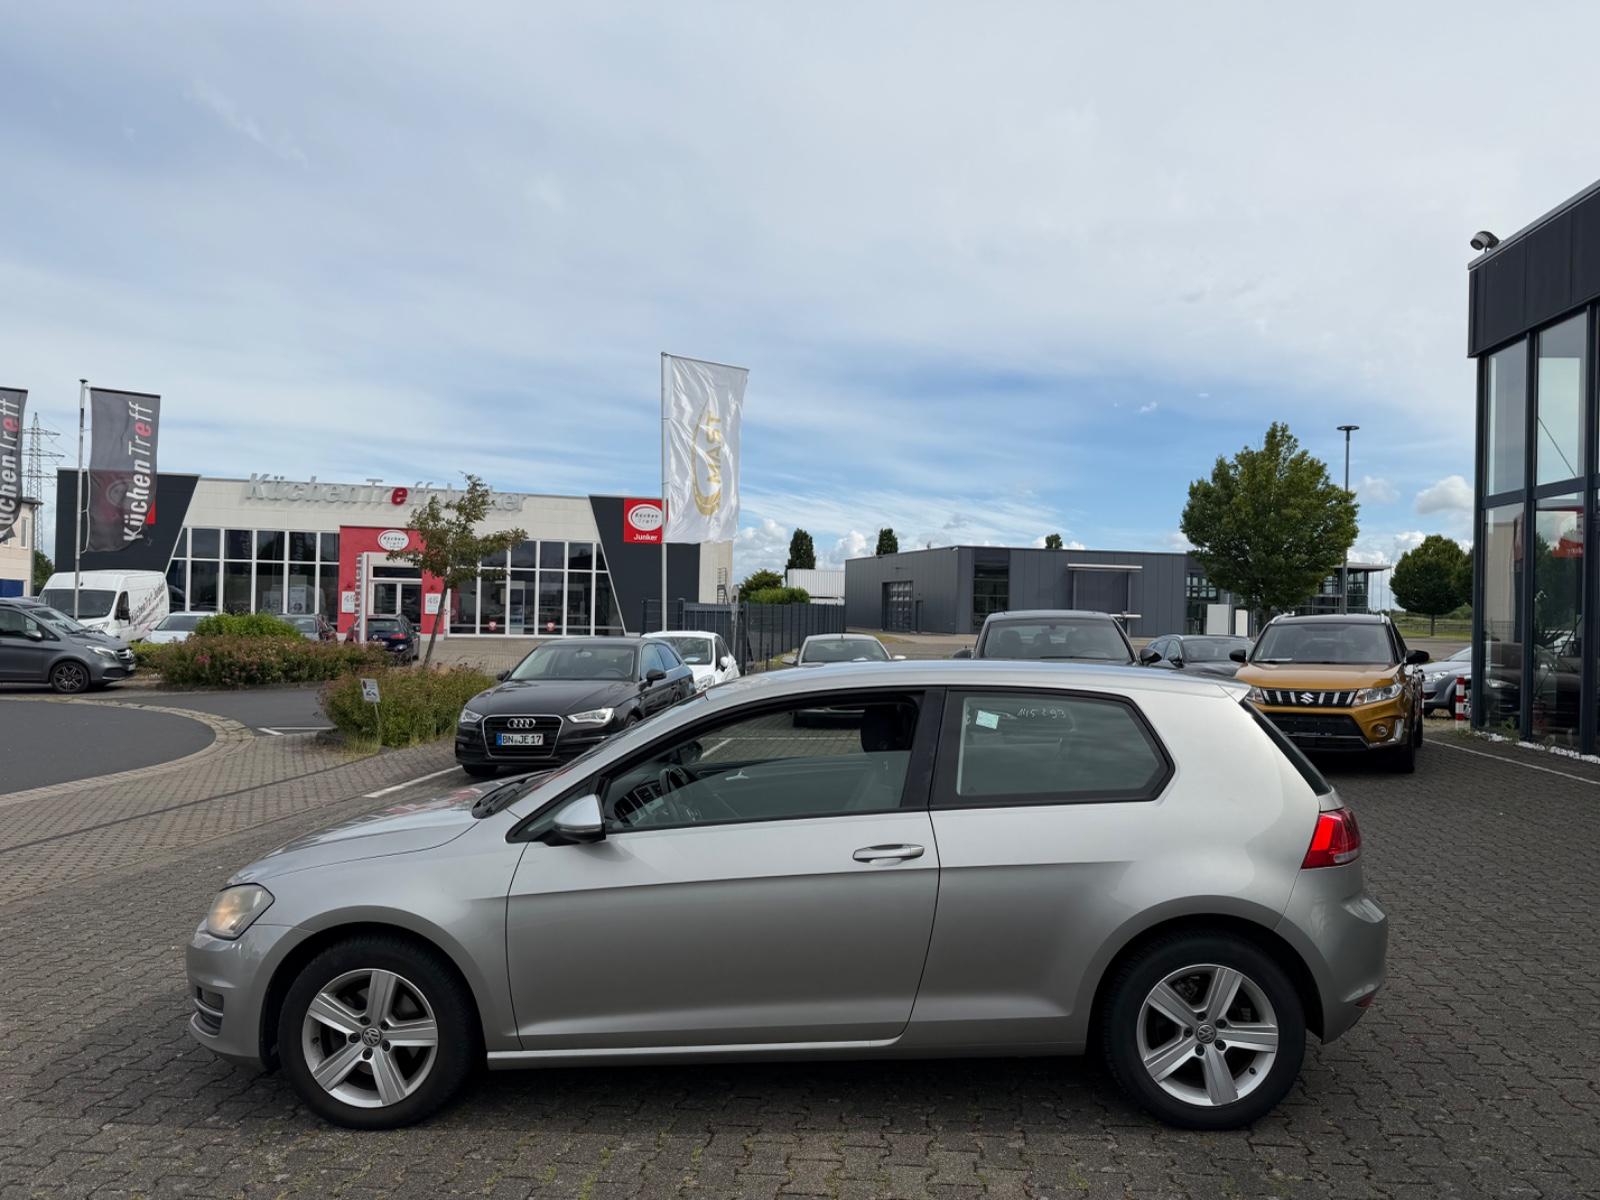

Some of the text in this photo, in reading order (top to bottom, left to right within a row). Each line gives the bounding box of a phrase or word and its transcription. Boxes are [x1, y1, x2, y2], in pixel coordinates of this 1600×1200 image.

[633, 533, 658, 541] Junker
[503, 735, 513, 744] BN
[531, 735, 541, 744] 17
